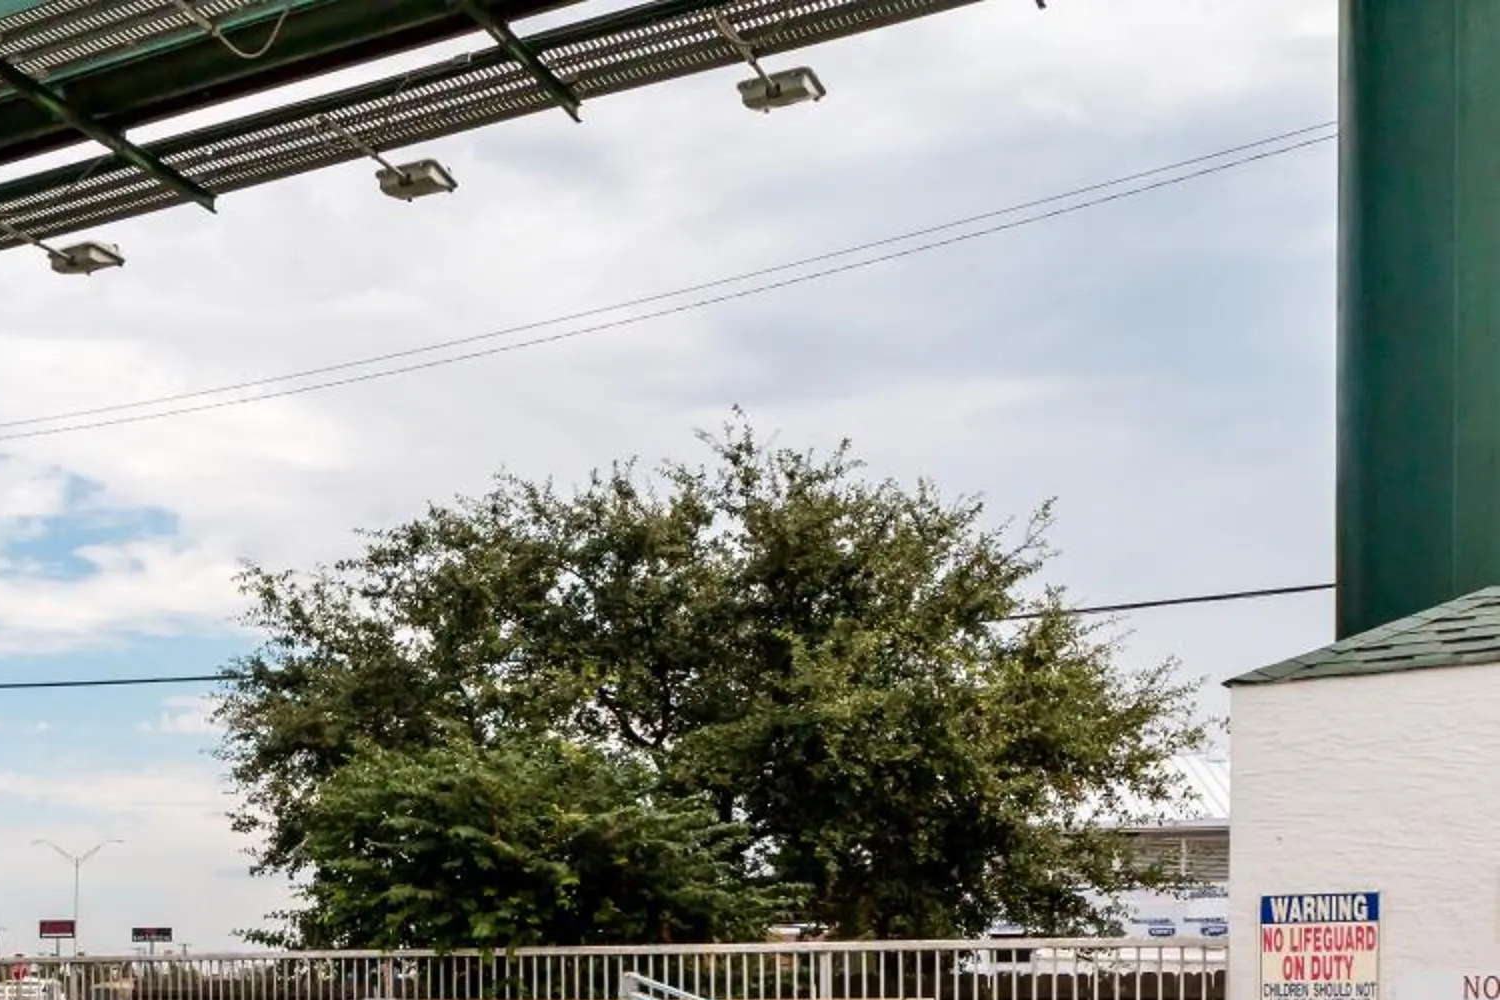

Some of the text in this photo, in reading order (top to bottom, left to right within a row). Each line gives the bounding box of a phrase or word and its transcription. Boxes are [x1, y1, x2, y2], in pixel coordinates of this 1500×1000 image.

[1270, 895, 1368, 922] WARNING
[1263, 926, 1376, 952] NO LIFEGUARD
[1283, 955, 1353, 980] ON DUTY
[1264, 982, 1377, 997] CHILDREN SHOULD NOT
[1463, 975, 1500, 1000] NO
